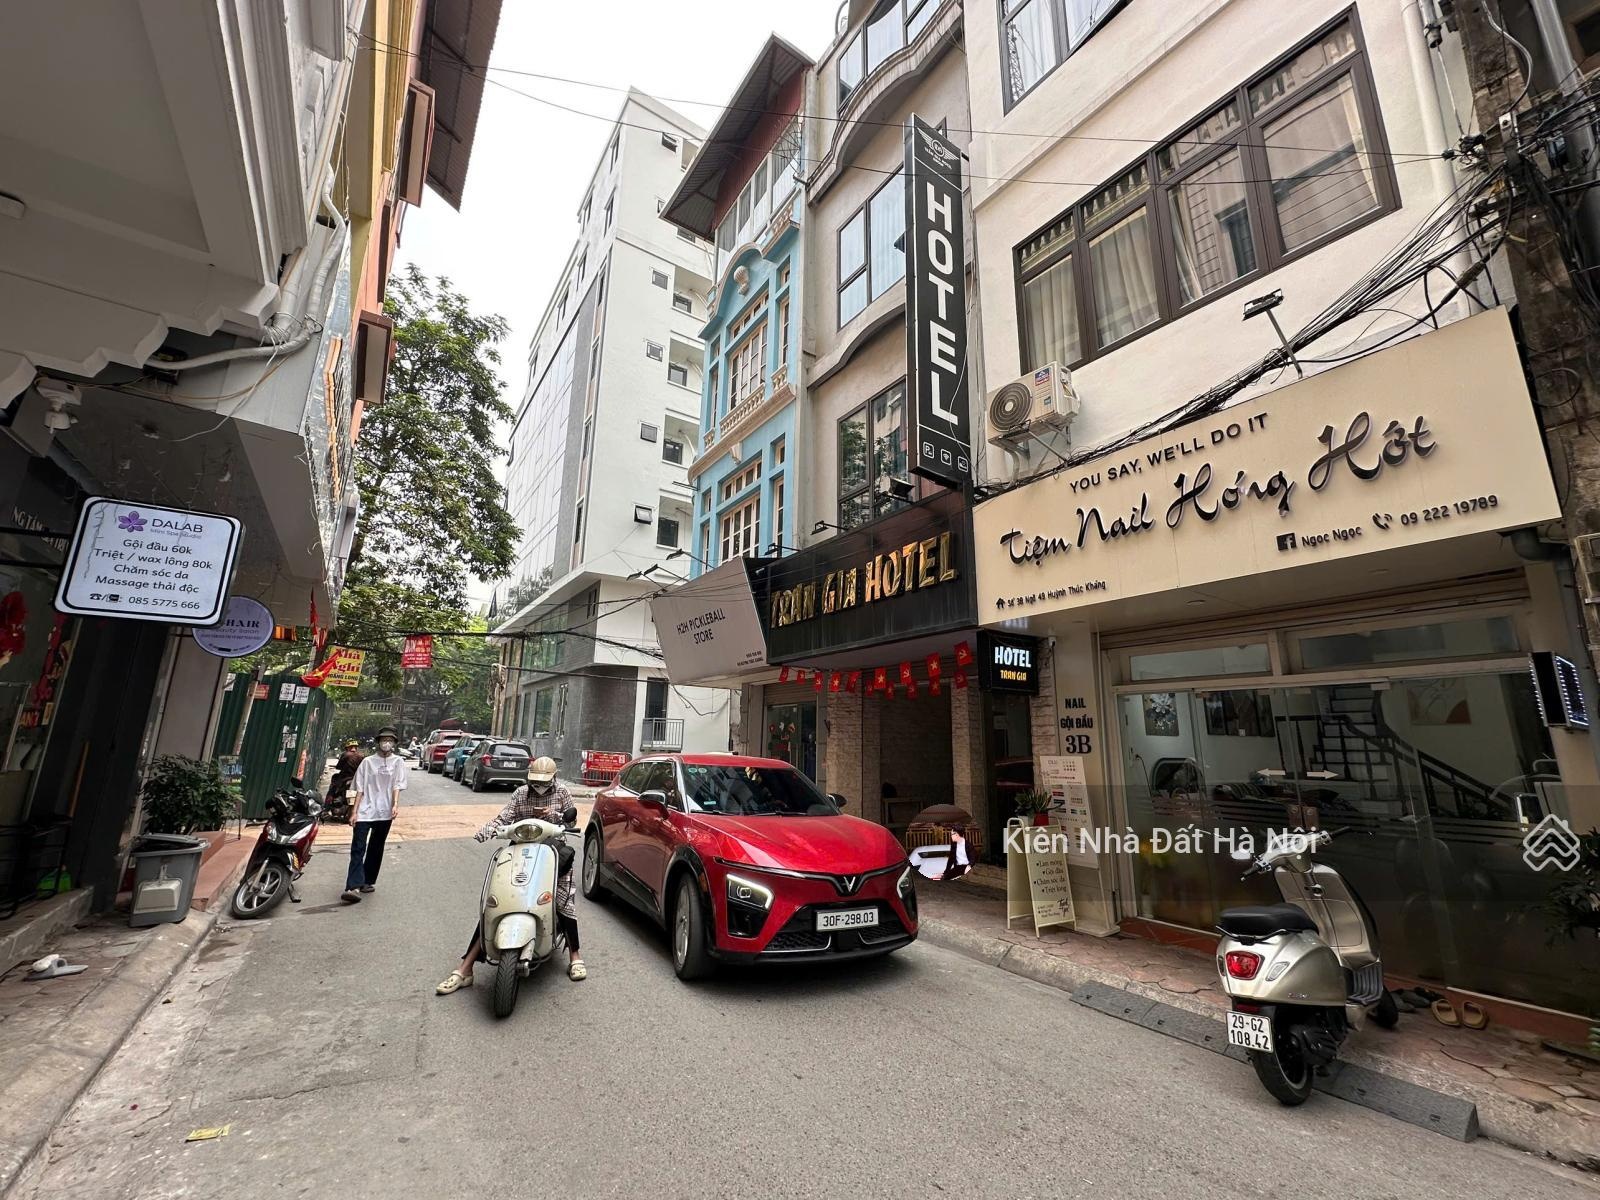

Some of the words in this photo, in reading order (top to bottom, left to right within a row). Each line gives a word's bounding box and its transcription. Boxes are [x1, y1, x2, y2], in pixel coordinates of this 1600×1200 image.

[926, 182, 958, 426] HOTEL
[1070, 473, 1101, 494] YOU
[1107, 458, 1143, 481] SAY,
[1147, 438, 1205, 466] WE'LL
[1211, 423, 1241, 445] DO
[1248, 413, 1268, 432] IT
[1076, 492, 1155, 548] Nail
[1166, 462, 1296, 528] Hóng
[1400, 512, 1418, 525] 09
[1423, 505, 1450, 521] 222
[1453, 495, 1498, 514] 19789
[152, 518, 203, 533] DALAB
[1332, 526, 1362, 541] Ngọc
[123, 539, 143, 550] Gội
[146, 541, 168, 552] đầu
[171, 545, 192, 555] 60k
[94, 548, 124, 561] Triệt
[138, 556, 161, 564] wax
[165, 556, 189, 569] lông
[193, 560, 213, 569] 80k
[114, 564, 148, 576] Chăm
[152, 569, 171, 578] sóc
[174, 570, 189, 580] da
[823, 567, 858, 615] GIA
[865, 531, 959, 603] HOTEL
[95, 576, 150, 590] Massage
[153, 581, 176, 592] thải
[179, 583, 199, 594] độc
[128, 596, 149, 605] 085
[152, 598, 177, 608] 5775
[181, 600, 200, 610] 666
[676, 623, 690, 635] H2H
[689, 608, 726, 631] PICKLEBALL
[693, 629, 714, 644] STORE
[995, 646, 1032, 668] HOTEL
[1065, 697, 1087, 709] NAIL
[1060, 715, 1074, 731] GỘI
[1066, 735, 1092, 754] 3B
[823, 912, 874, 927] 30F-298.03
[1230, 1030, 1270, 1050] 108.42
